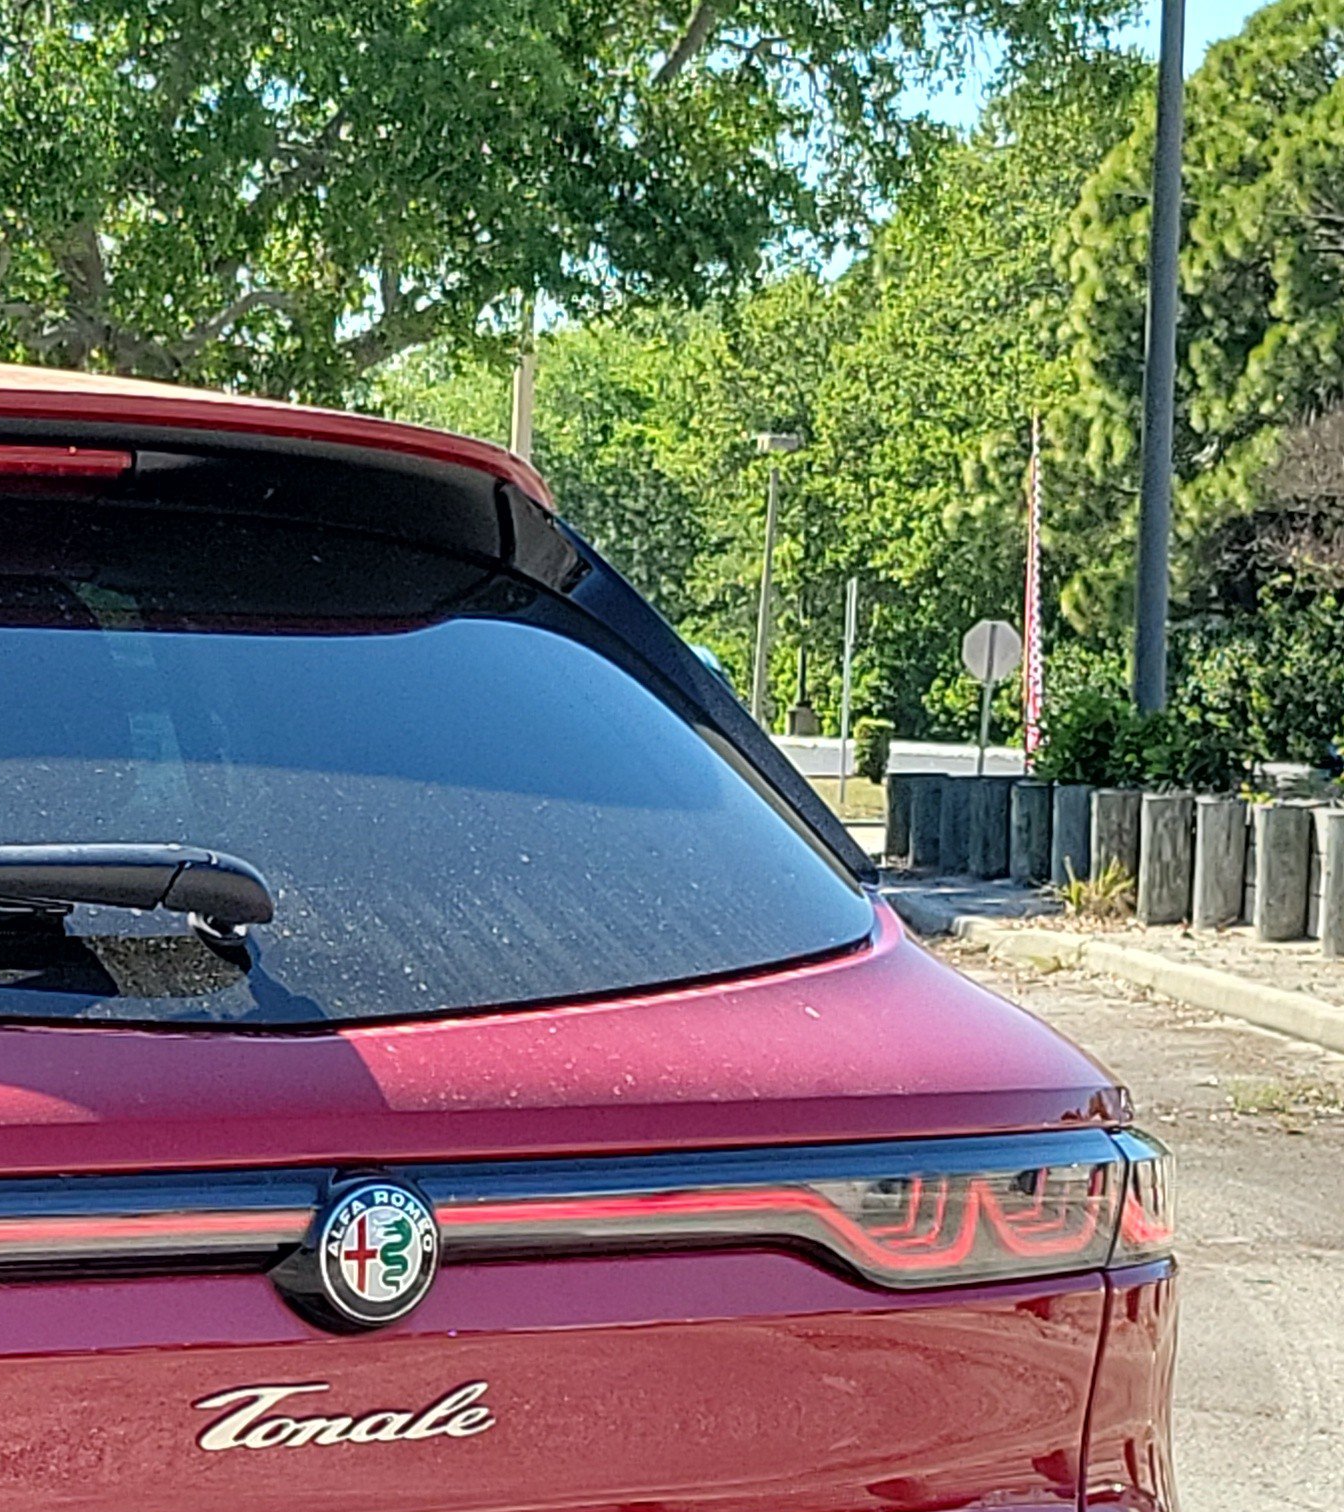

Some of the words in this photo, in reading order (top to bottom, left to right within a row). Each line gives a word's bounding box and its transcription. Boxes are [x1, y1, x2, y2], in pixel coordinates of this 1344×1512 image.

[327, 1199, 367, 1258] ALFA
[373, 1190, 433, 1253] ROMEO
[192, 1381, 496, 1451] Tonale
